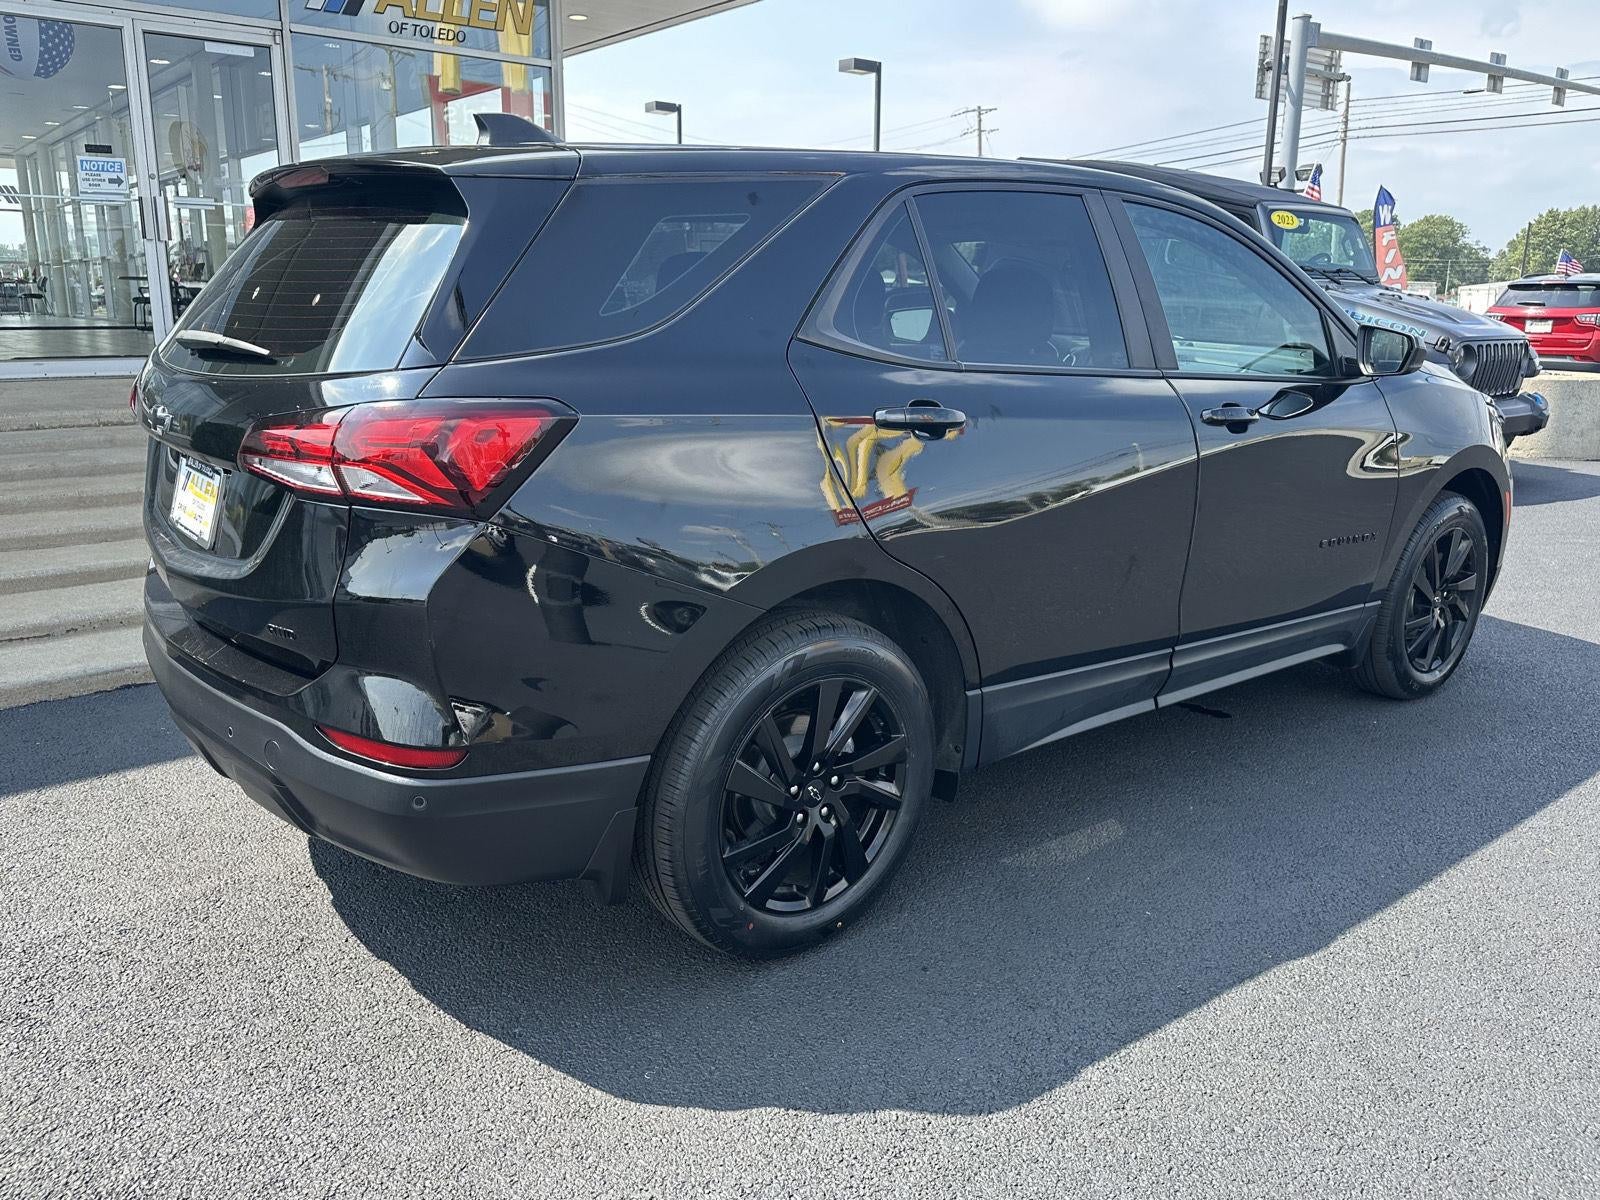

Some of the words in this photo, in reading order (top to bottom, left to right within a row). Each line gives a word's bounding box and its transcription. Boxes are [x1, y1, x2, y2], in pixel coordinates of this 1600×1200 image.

[2, 14, 23, 62] OWNED
[389, 20, 409, 35] OF
[411, 23, 467, 43] TOLEDO
[82, 160, 121, 172] NOTICE
[1276, 214, 1295, 226] 2023
[1344, 308, 1429, 339] BICON
